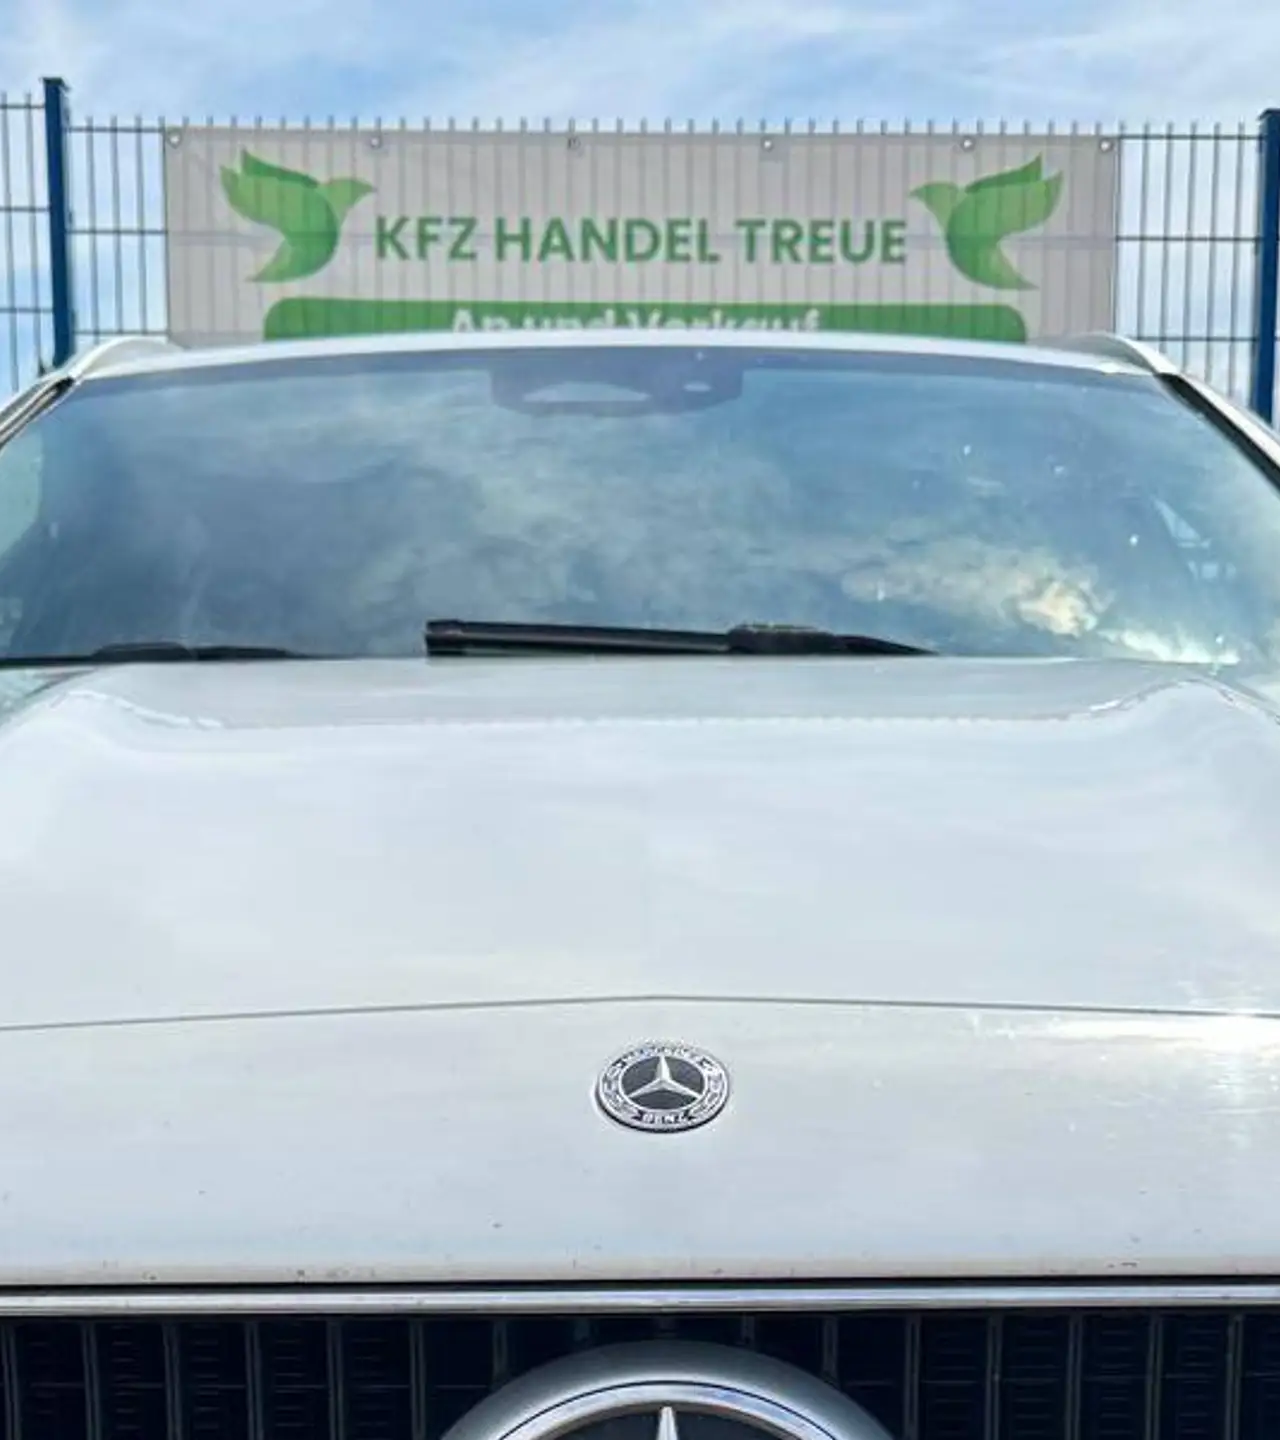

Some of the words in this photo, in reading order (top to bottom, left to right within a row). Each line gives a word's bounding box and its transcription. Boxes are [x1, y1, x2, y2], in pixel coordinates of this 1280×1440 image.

[376, 216, 478, 261] KFZ
[494, 217, 719, 263] HANDEL
[735, 219, 907, 264] TREUE
